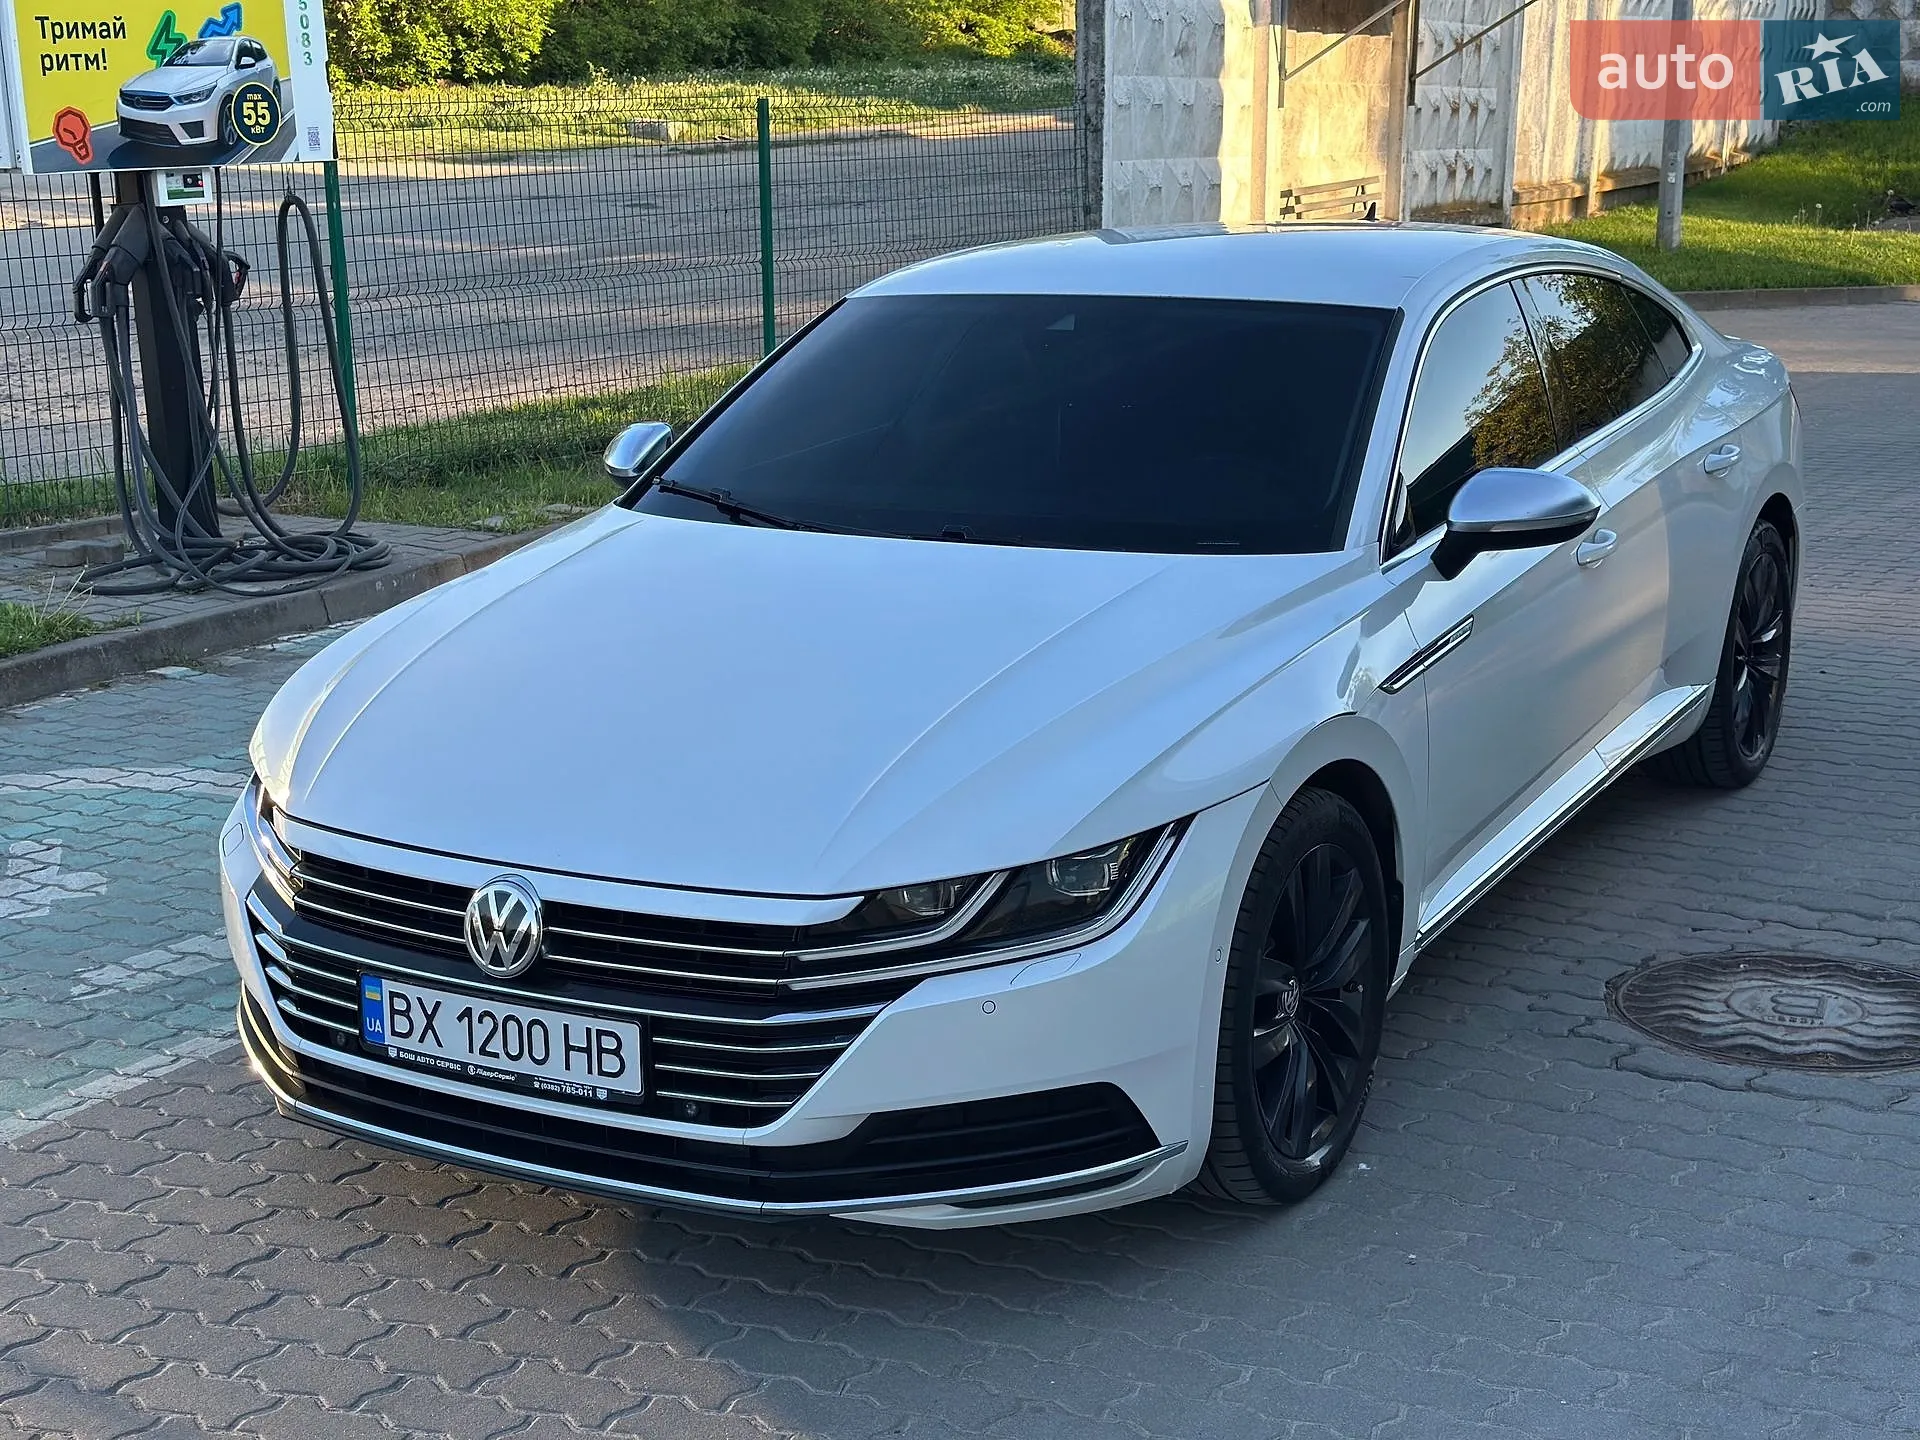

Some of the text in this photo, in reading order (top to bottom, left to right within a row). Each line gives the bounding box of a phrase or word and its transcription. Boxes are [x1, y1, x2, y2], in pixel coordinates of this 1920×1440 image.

[35, 16, 126, 44] Тримай
[40, 48, 107, 76] ритм!
[243, 102, 270, 126] 55
[251, 125, 265, 134] кВт
[366, 1016, 382, 1035] UA
[388, 989, 627, 1080] BX 1200 HB
[399, 1051, 416, 1061] БОШ
[416, 1056, 435, 1066] АВТО
